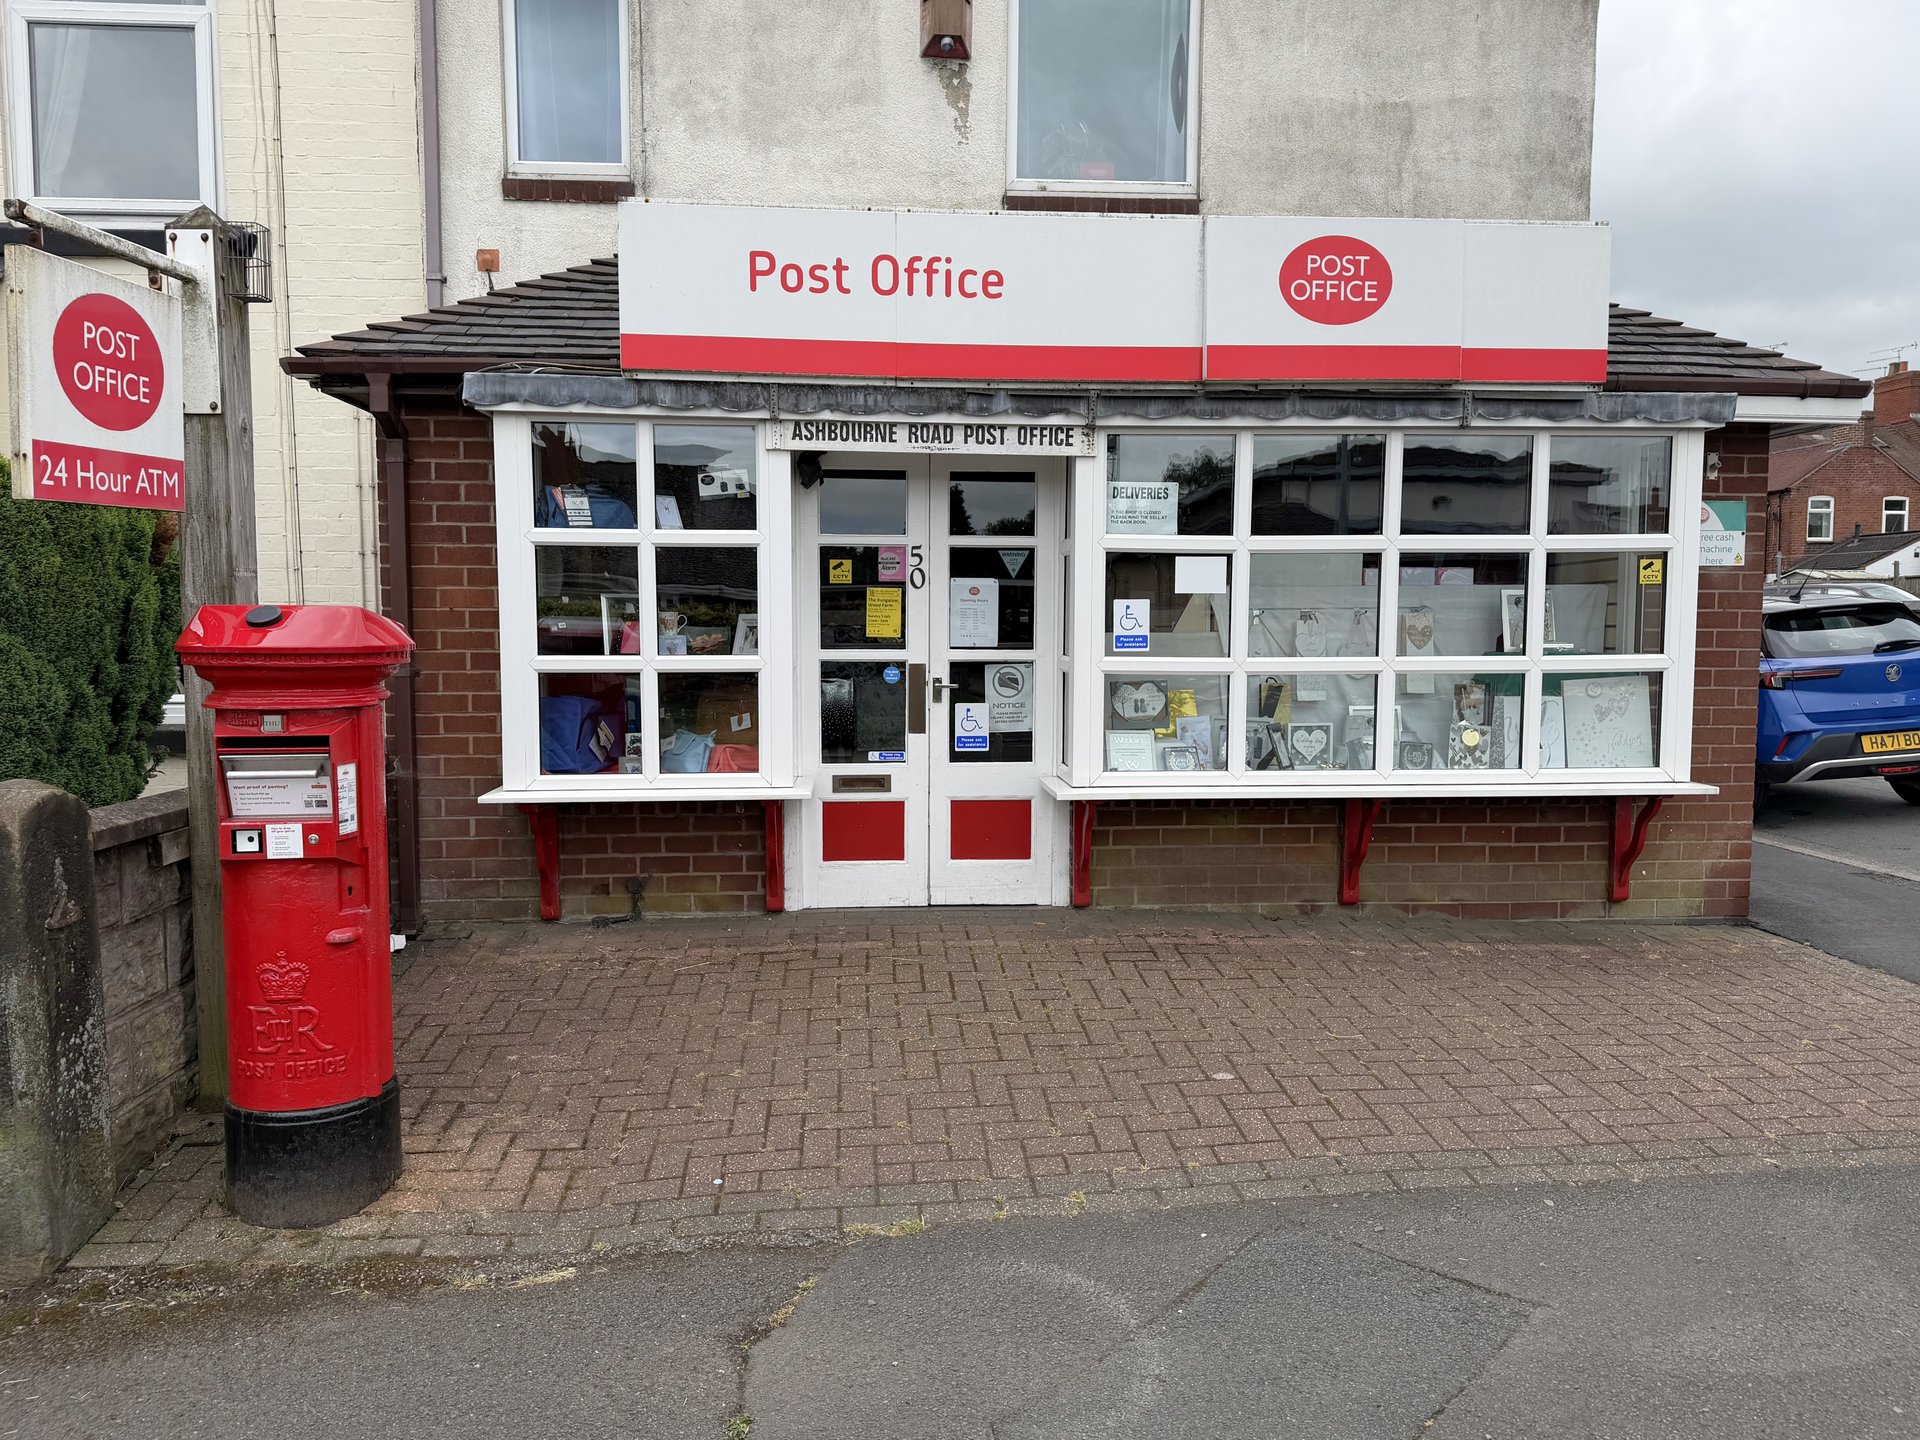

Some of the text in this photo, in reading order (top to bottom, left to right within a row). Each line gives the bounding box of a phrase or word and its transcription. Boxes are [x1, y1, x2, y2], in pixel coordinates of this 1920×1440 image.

[749, 250, 1004, 299] Post Office
[1307, 254, 1371, 277] POST
[1290, 279, 1378, 302] OFFICE
[83, 320, 140, 362] POST
[73, 361, 150, 404] OFFICE
[791, 422, 1074, 447] ASHBOURNE ROAD POST OFFICE
[39, 454, 180, 499] 24 Hour ATM
[1112, 486, 1169, 500] DELIVERIES
[1715, 533, 1734, 542] cash
[1705, 557, 1724, 565] here
[1870, 735, 1900, 749] HA71
[238, 1055, 346, 1079] POST OFFICE
